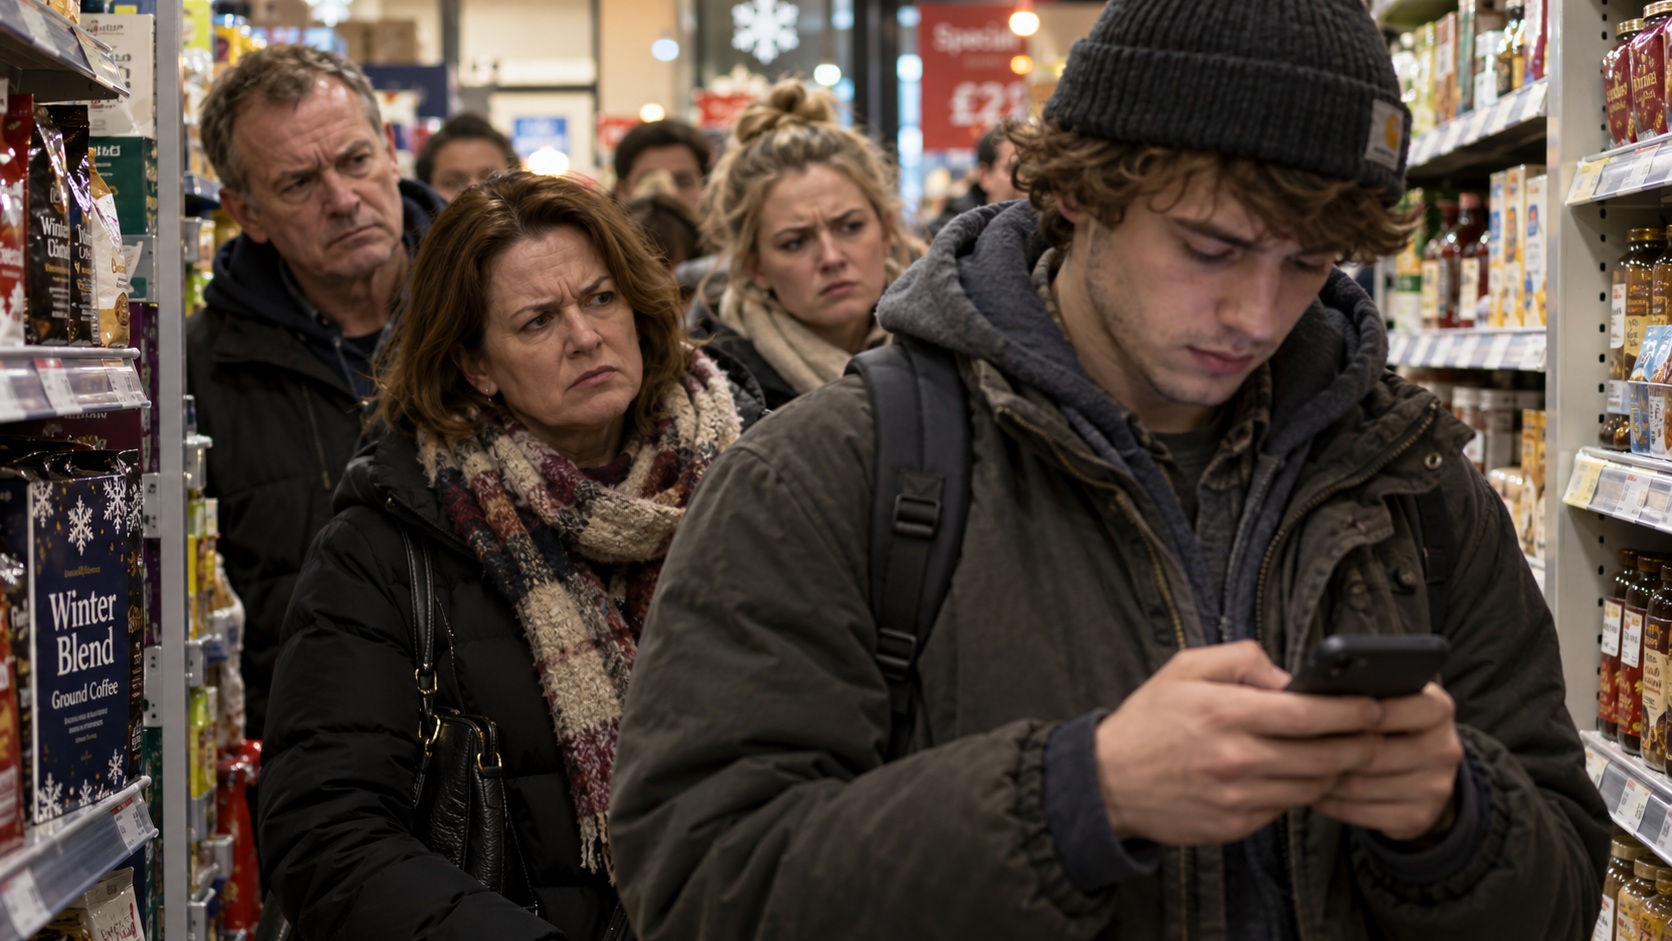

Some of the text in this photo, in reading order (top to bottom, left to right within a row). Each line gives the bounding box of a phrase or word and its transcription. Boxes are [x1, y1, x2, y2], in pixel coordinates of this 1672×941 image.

[40, 215, 70, 238] Winte
[48, 589, 117, 631] Winter
[56, 626, 115, 676] Blend
[51, 678, 119, 709] Ground Coffee
